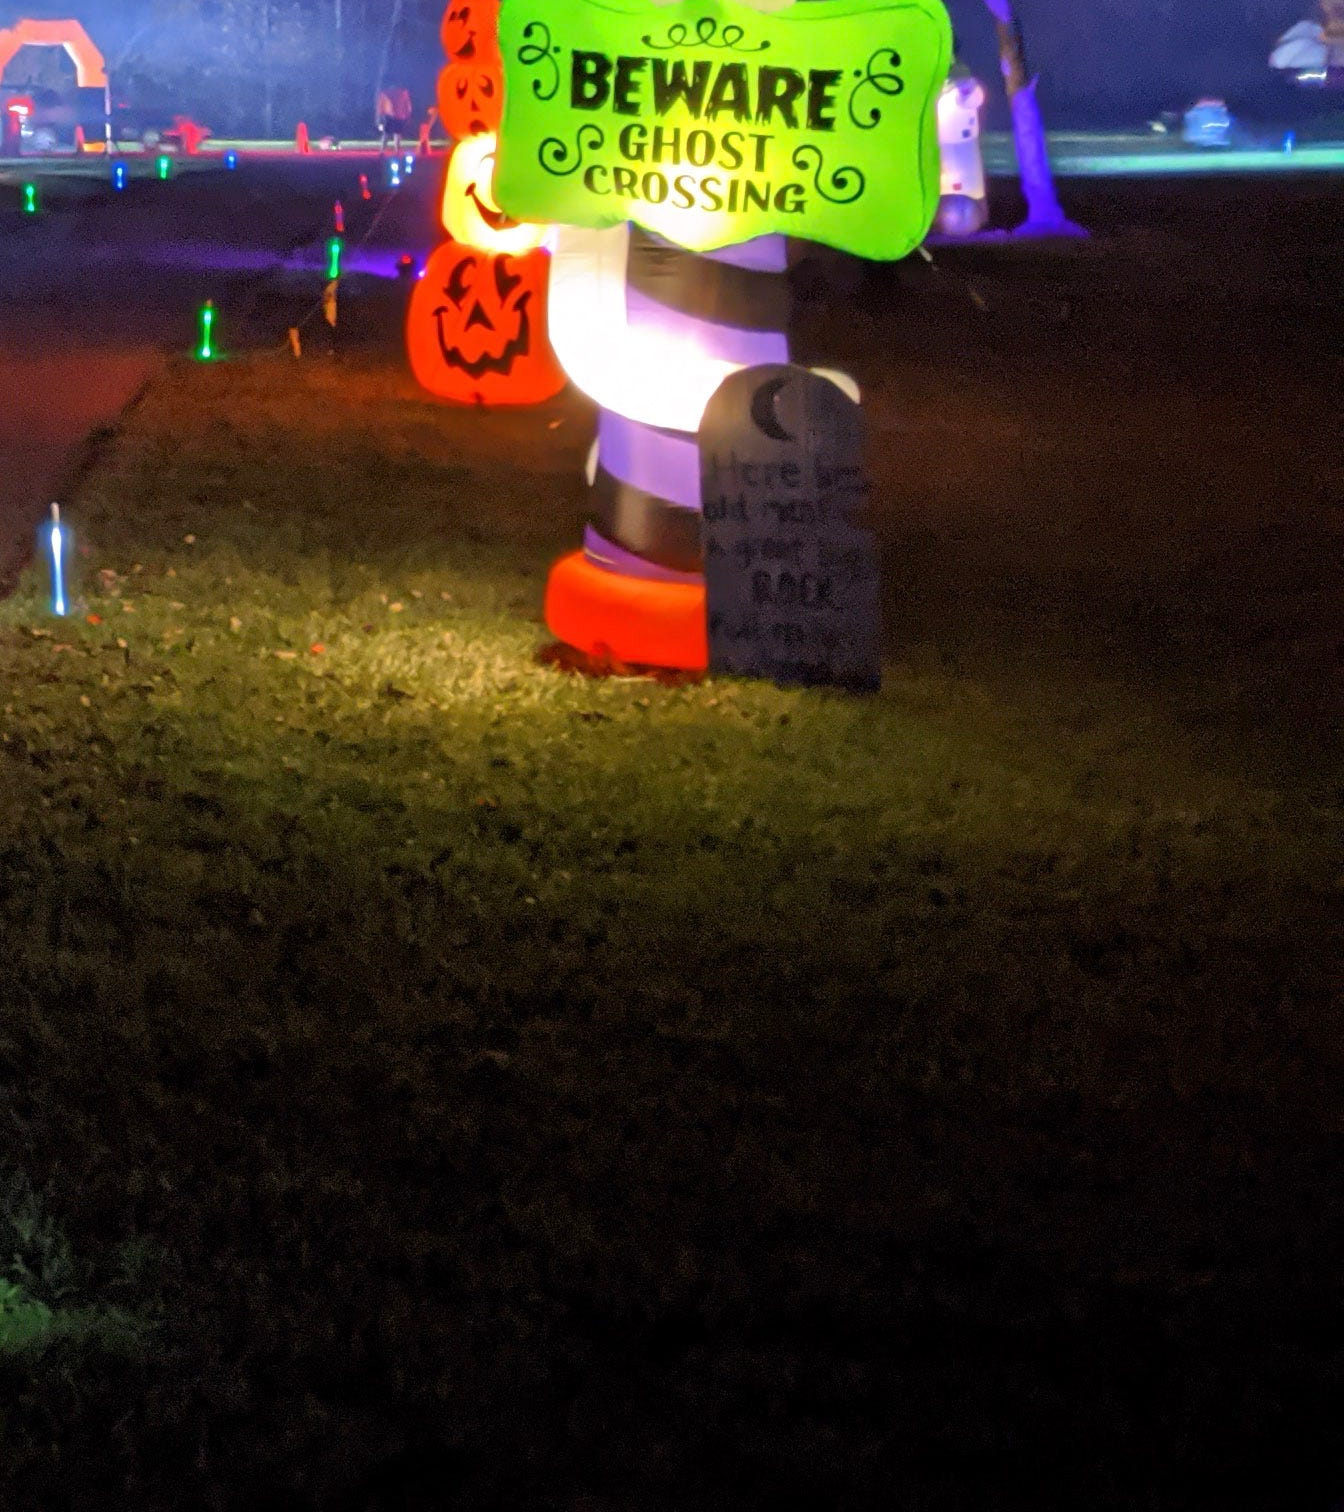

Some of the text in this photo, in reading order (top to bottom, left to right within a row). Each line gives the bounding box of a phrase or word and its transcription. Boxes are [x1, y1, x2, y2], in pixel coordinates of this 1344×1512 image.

[571, 50, 843, 131] BEWARE
[619, 124, 776, 173] GHOST
[583, 164, 808, 215] CROSSING
